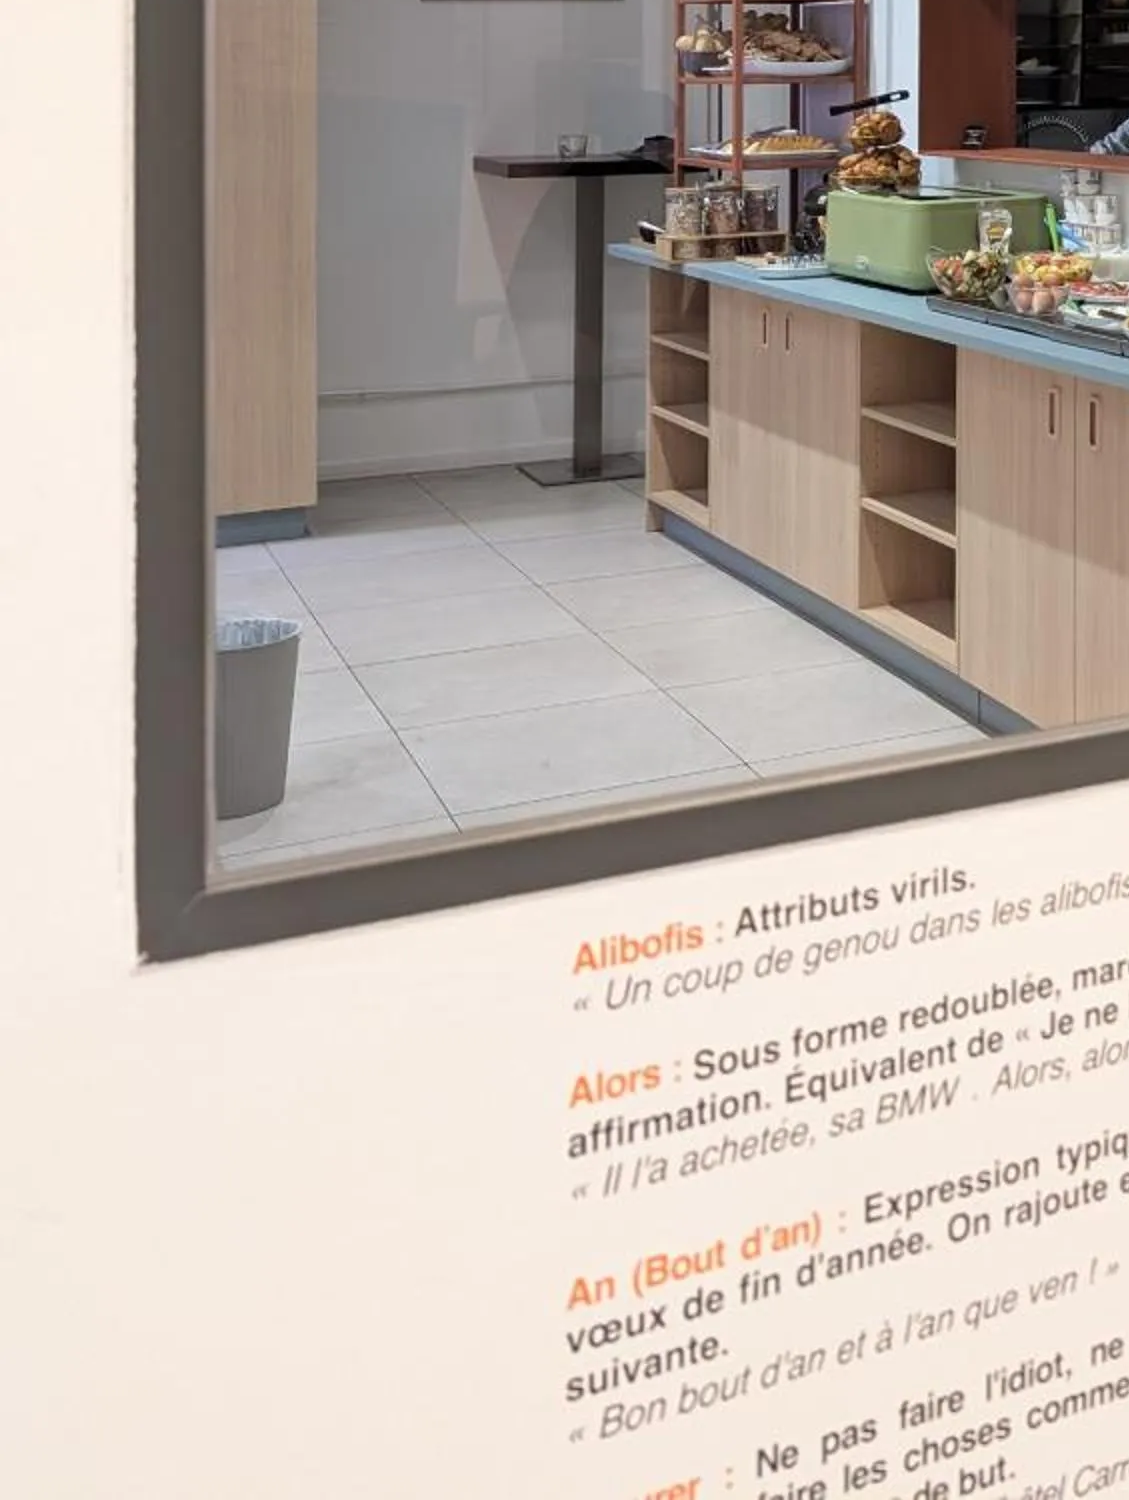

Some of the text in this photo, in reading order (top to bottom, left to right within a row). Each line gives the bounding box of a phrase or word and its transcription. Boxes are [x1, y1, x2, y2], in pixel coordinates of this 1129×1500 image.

[573, 867, 975, 974] Alibofis Attributs virils.
[567, 1089, 770, 1158] affirmation.
[785, 1037, 956, 1103] Équivalent
[967, 1028, 1003, 1057] de
[1040, 1010, 1074, 1039] Je
[1084, 1002, 1118, 1028] ne
[569, 1064, 660, 1108] Alors
[693, 1040, 780, 1080] Sous
[792, 1015, 887, 1057] forme
[899, 977, 1061, 1032] redoublée,
[566, 1305, 666, 1353] vœux
[682, 1288, 724, 1321] de
[739, 1272, 780, 1304] fin
[796, 1232, 931, 1287] d'année.
[947, 1212, 990, 1243] On
[1004, 1179, 1107, 1227] rajoute
[567, 1276, 614, 1310] An
[632, 1240, 724, 1298] (Bout
[864, 1156, 1039, 1224] Expression
[565, 1336, 727, 1401] suivante.
